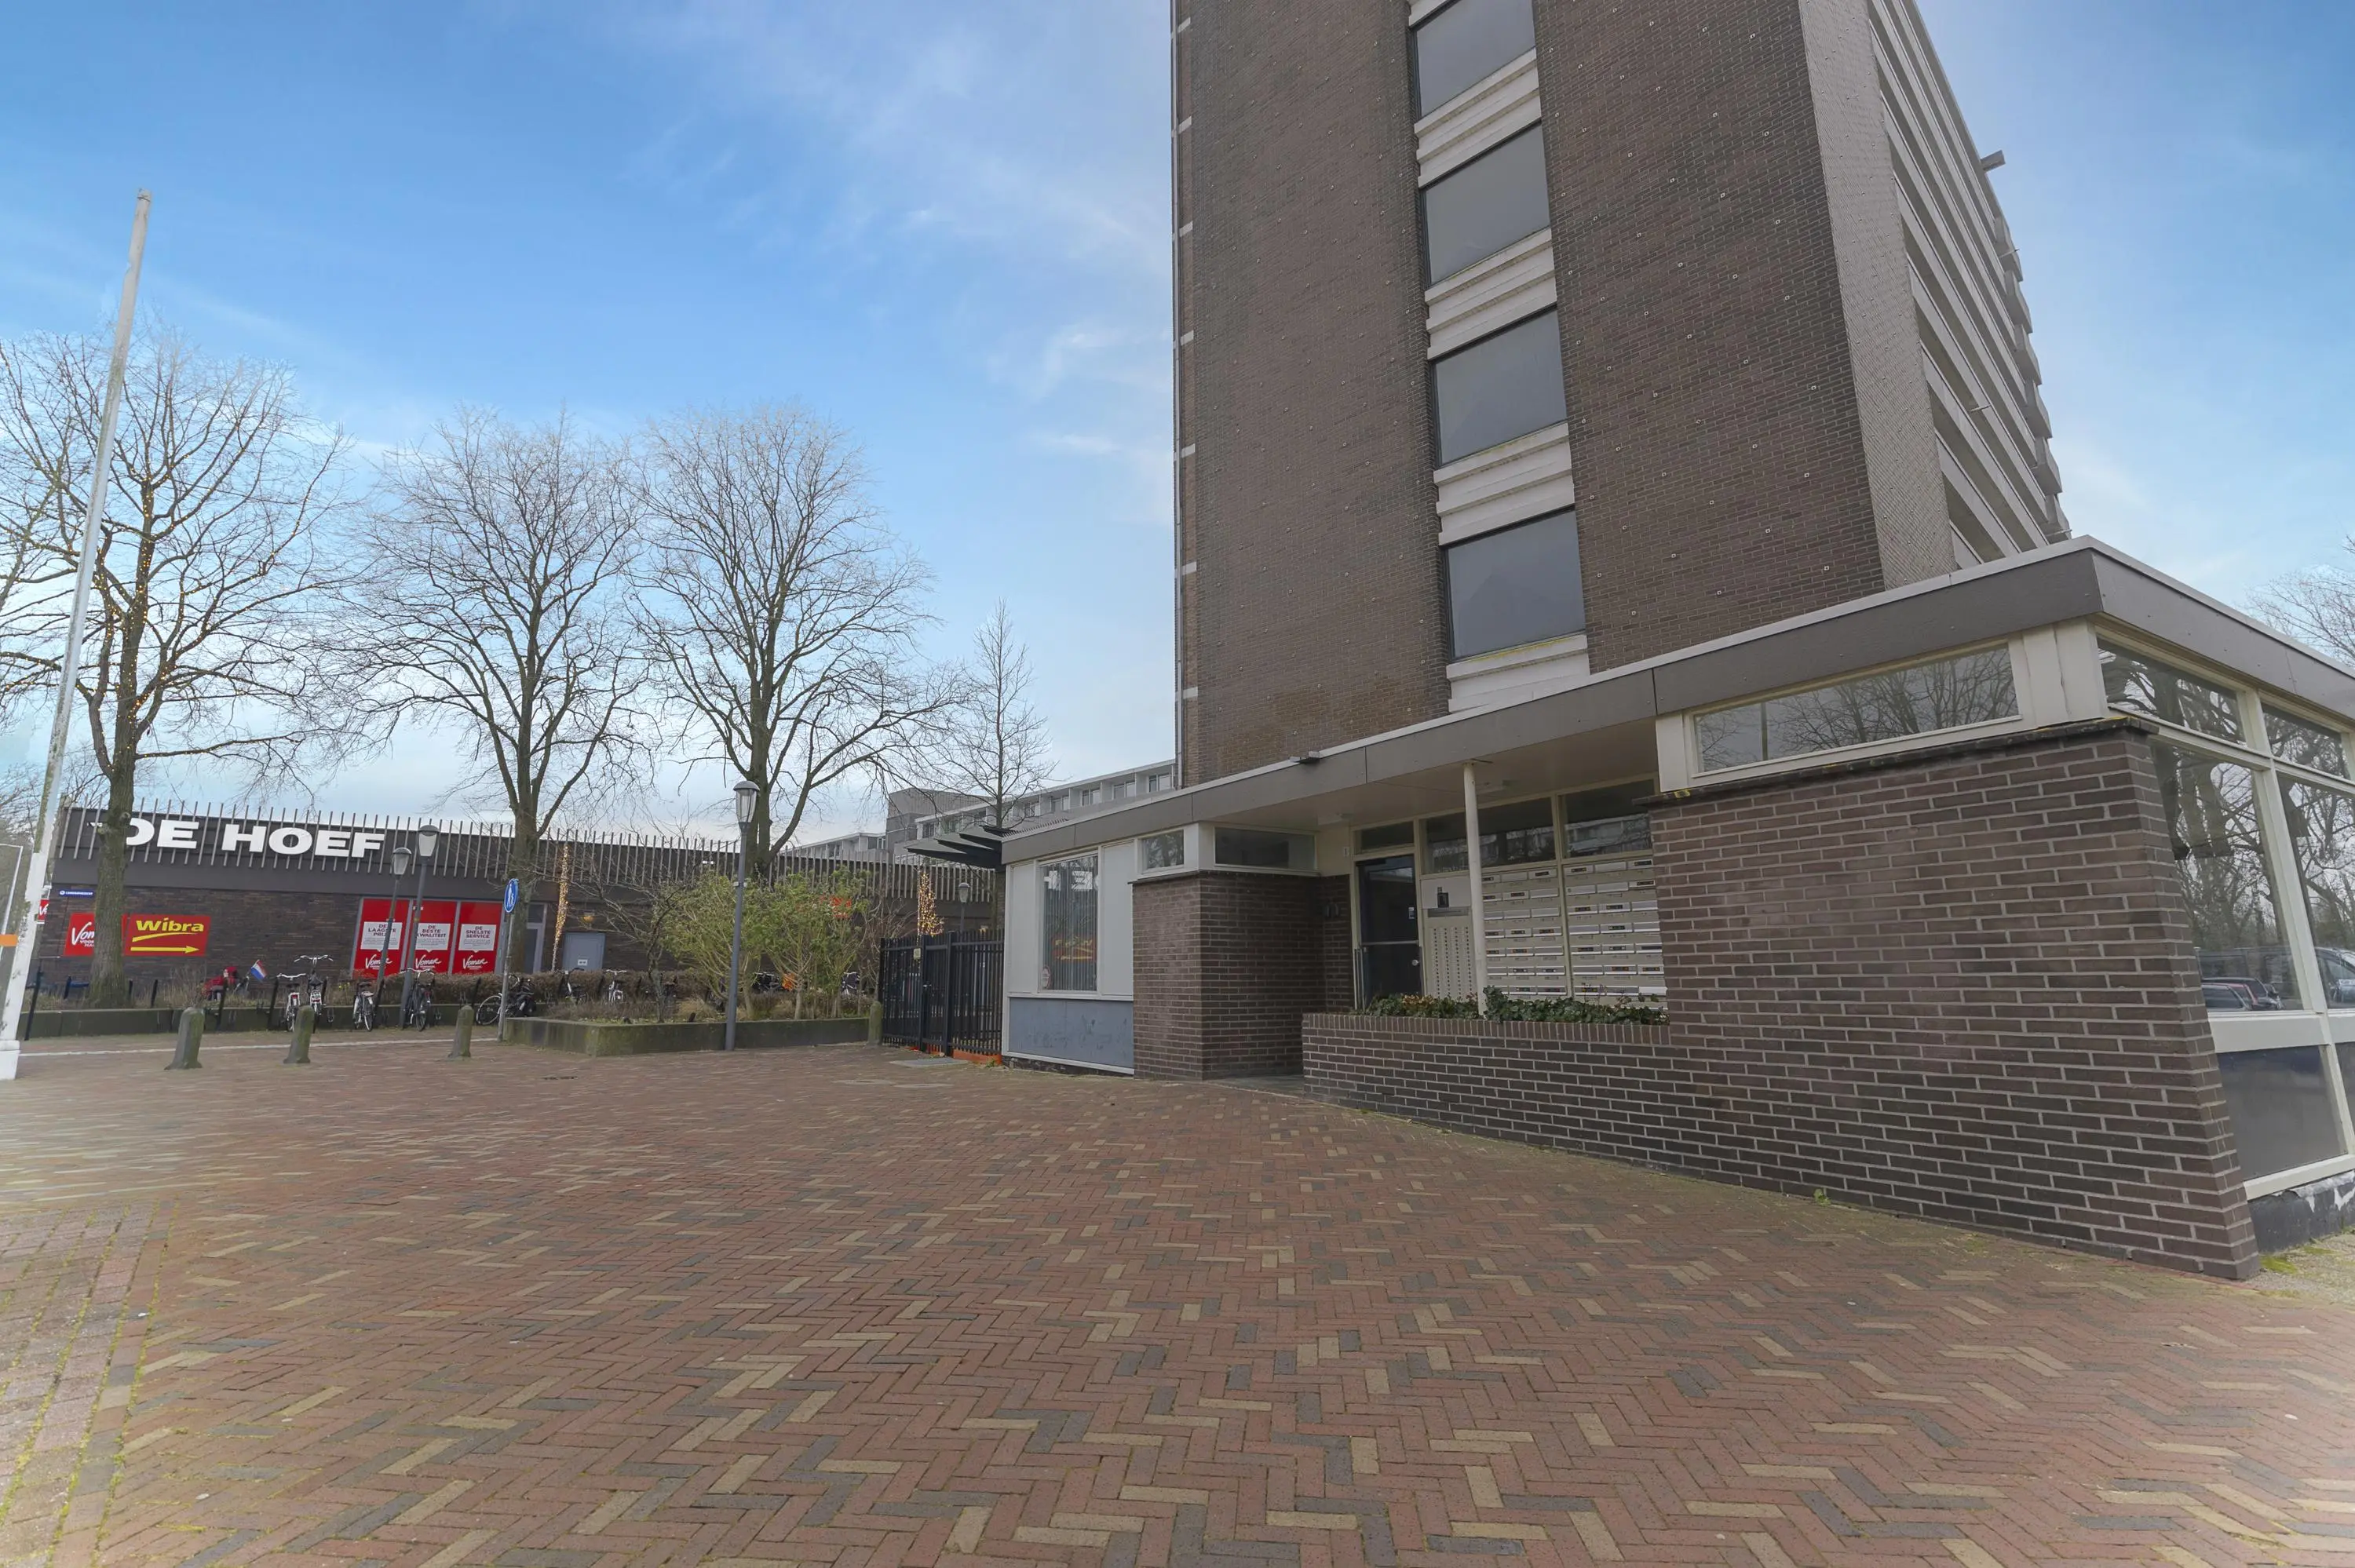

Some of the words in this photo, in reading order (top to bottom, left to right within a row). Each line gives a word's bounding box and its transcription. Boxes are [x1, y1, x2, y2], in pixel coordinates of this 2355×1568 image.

[126, 818, 199, 849] DE
[221, 823, 385, 859] HOEF
[71, 921, 95, 946] Vom
[136, 917, 204, 932] Wibra
[365, 954, 393, 969] Vomr
